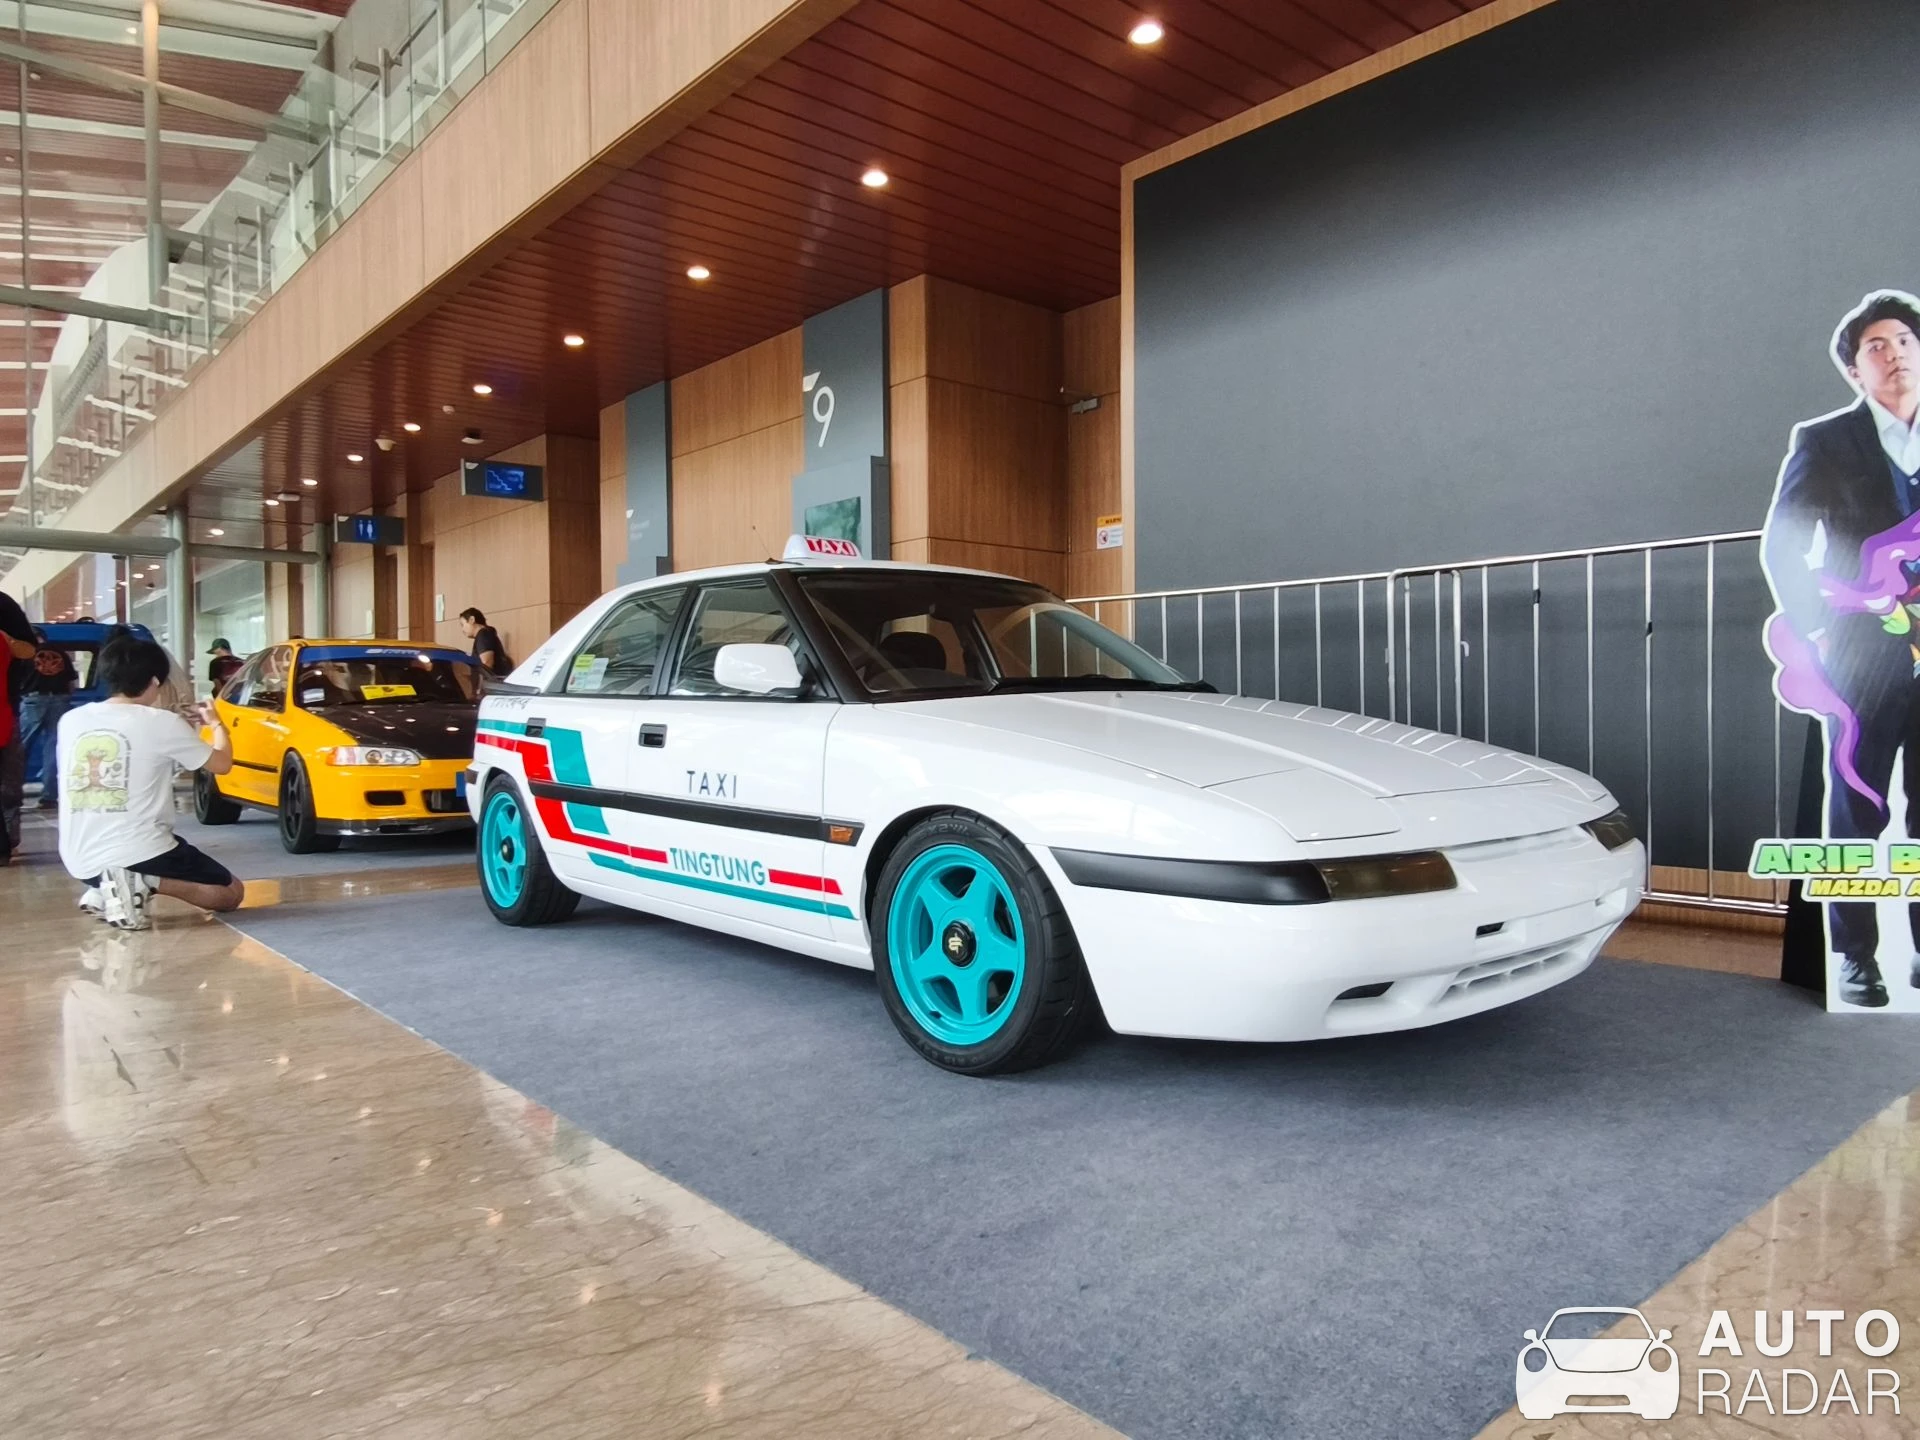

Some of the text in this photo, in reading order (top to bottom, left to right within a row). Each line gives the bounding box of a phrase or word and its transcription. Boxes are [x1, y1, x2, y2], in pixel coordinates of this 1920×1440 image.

[813, 385, 835, 448] 9
[807, 537, 857, 556] TAXI
[686, 770, 737, 798] TAXI
[669, 847, 766, 886] TINGTUNG
[1755, 844, 1873, 874] ARIF
[1807, 878, 1901, 897] MAZDA
